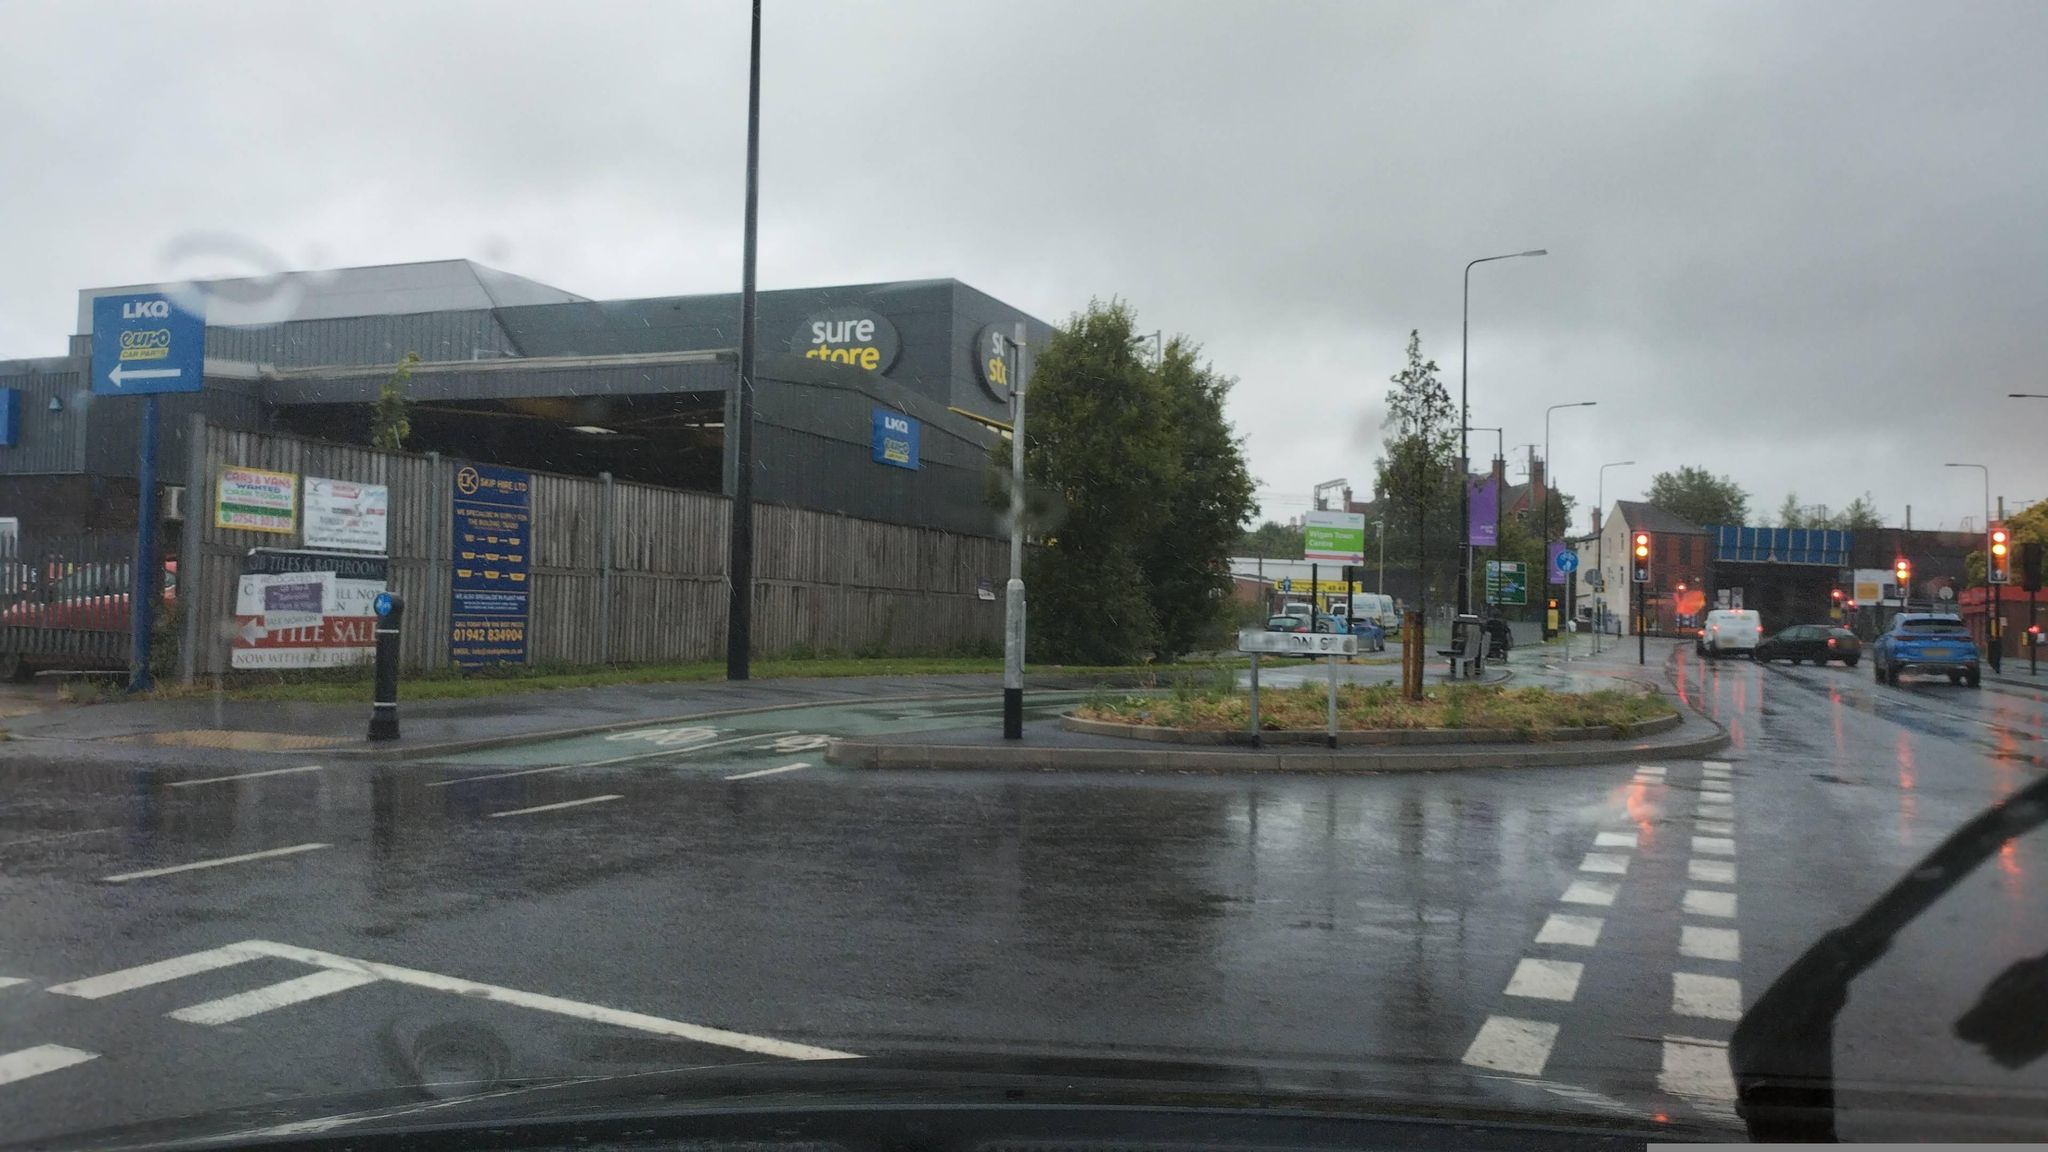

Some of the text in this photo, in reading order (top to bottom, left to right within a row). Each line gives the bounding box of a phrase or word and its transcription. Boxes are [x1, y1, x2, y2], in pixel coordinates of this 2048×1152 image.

[123, 301, 169, 319] LKQ
[121, 329, 171, 349] euro
[812, 319, 875, 344] sure
[122, 349, 166, 359] CAR PARTS
[885, 416, 908, 434] LKQ
[236, 483, 282, 494] WANTED
[270, 556, 301, 572] TILES
[315, 558, 384, 576] BATHROOMS
[454, 629, 523, 642] 01942 834904
